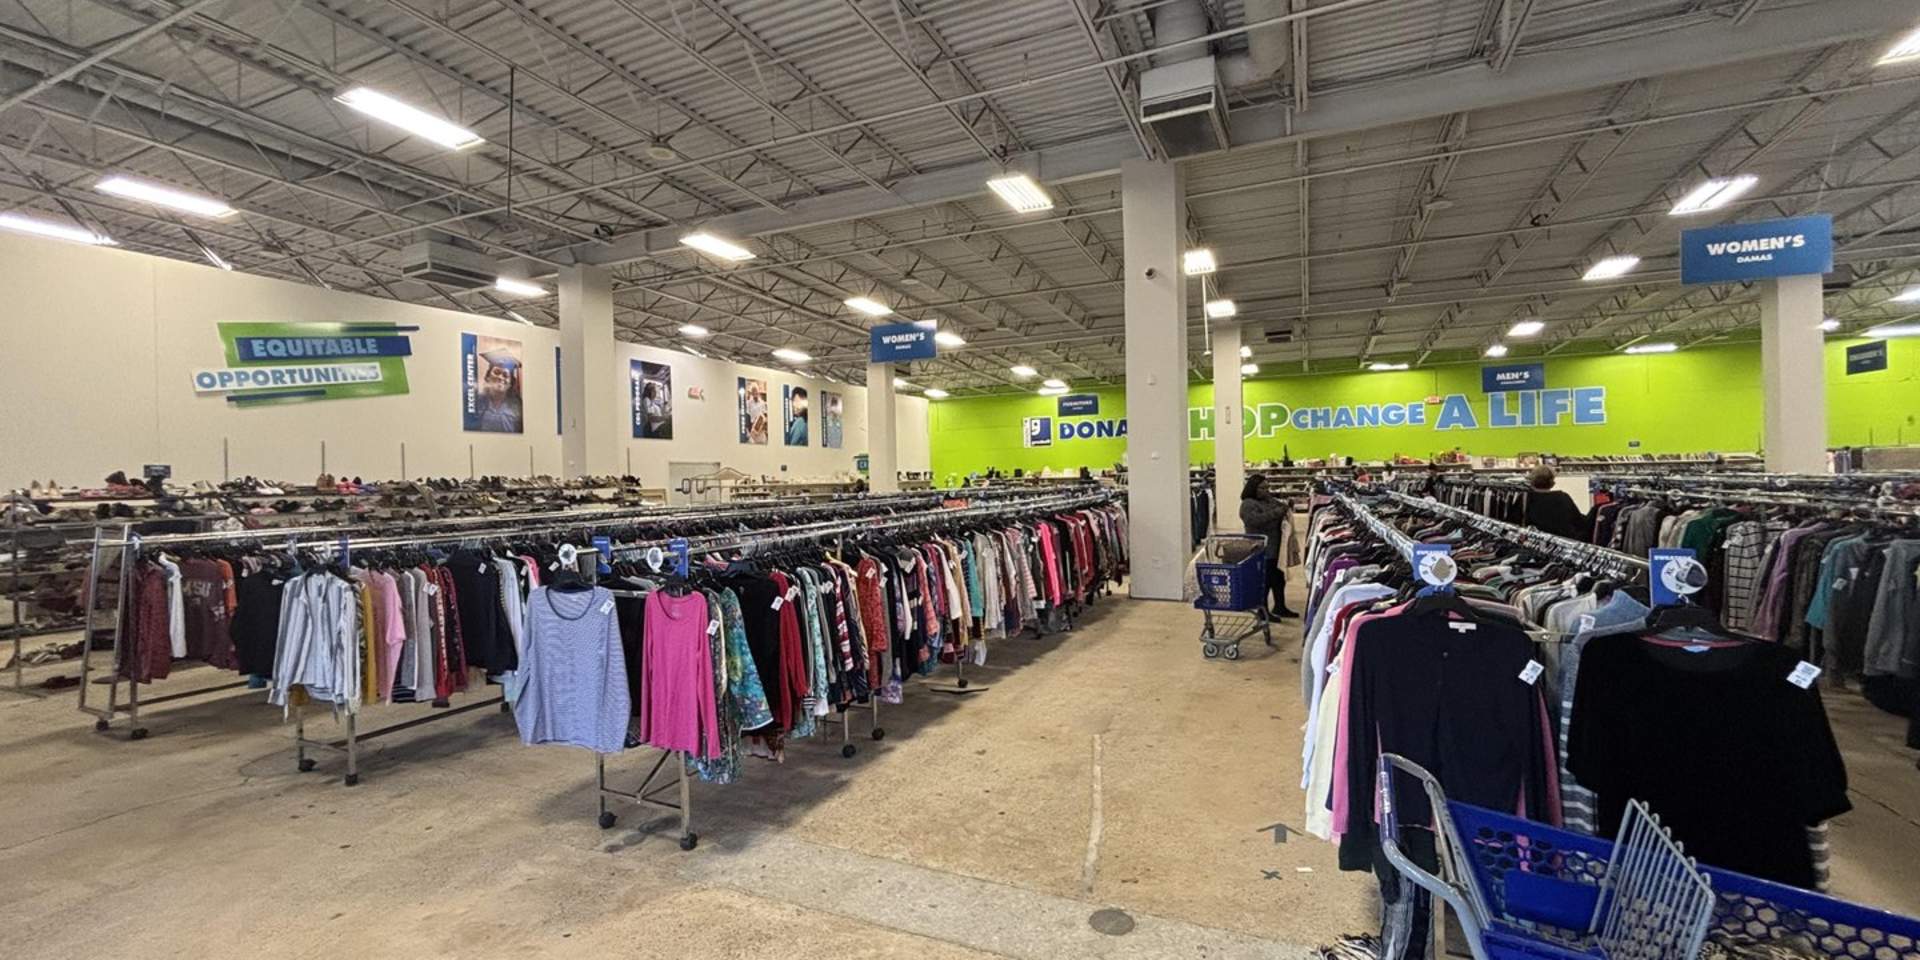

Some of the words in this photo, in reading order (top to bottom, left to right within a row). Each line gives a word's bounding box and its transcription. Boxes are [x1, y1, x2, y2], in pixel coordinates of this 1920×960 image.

[1706, 234, 1806, 256] WOMEN'S
[1736, 253, 1773, 264] DAMAS
[251, 338, 378, 357] EQUITABLE
[882, 332, 925, 344] WOMEN'S
[466, 354, 475, 386] CENTER
[1496, 371, 1530, 381] MEN'S
[467, 388, 476, 413] EXCEL
[1059, 419, 1127, 439] DONA
[1291, 403, 1425, 430] CHANGE
[1435, 394, 1479, 430] A
[1489, 387, 1605, 428] LIFE
